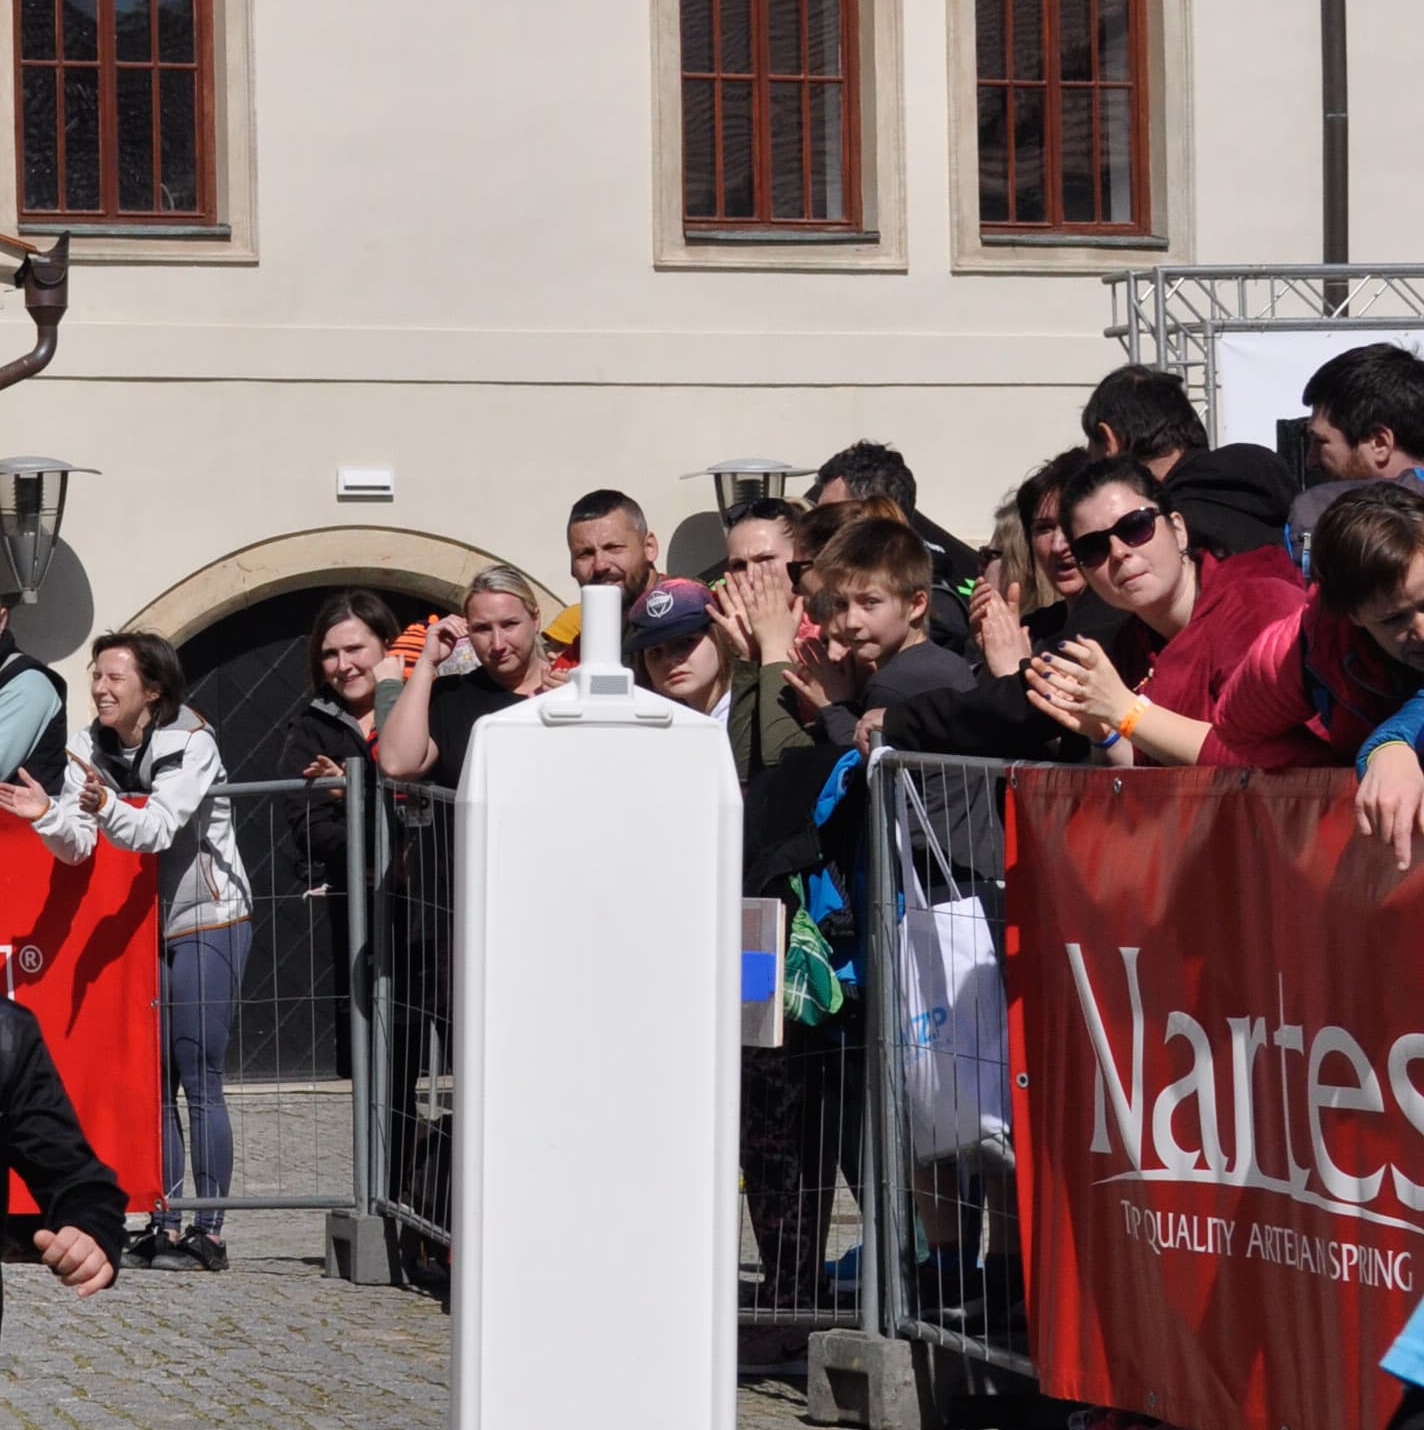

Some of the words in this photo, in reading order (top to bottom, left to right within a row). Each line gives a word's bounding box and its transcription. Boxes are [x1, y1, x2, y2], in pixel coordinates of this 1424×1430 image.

[1121, 1199, 1141, 1241] TP
[1143, 1209, 1236, 1258] QUALITY
[1245, 1222, 1327, 1276] ARTEIAN
[1328, 1240, 1413, 1292] SPRING
